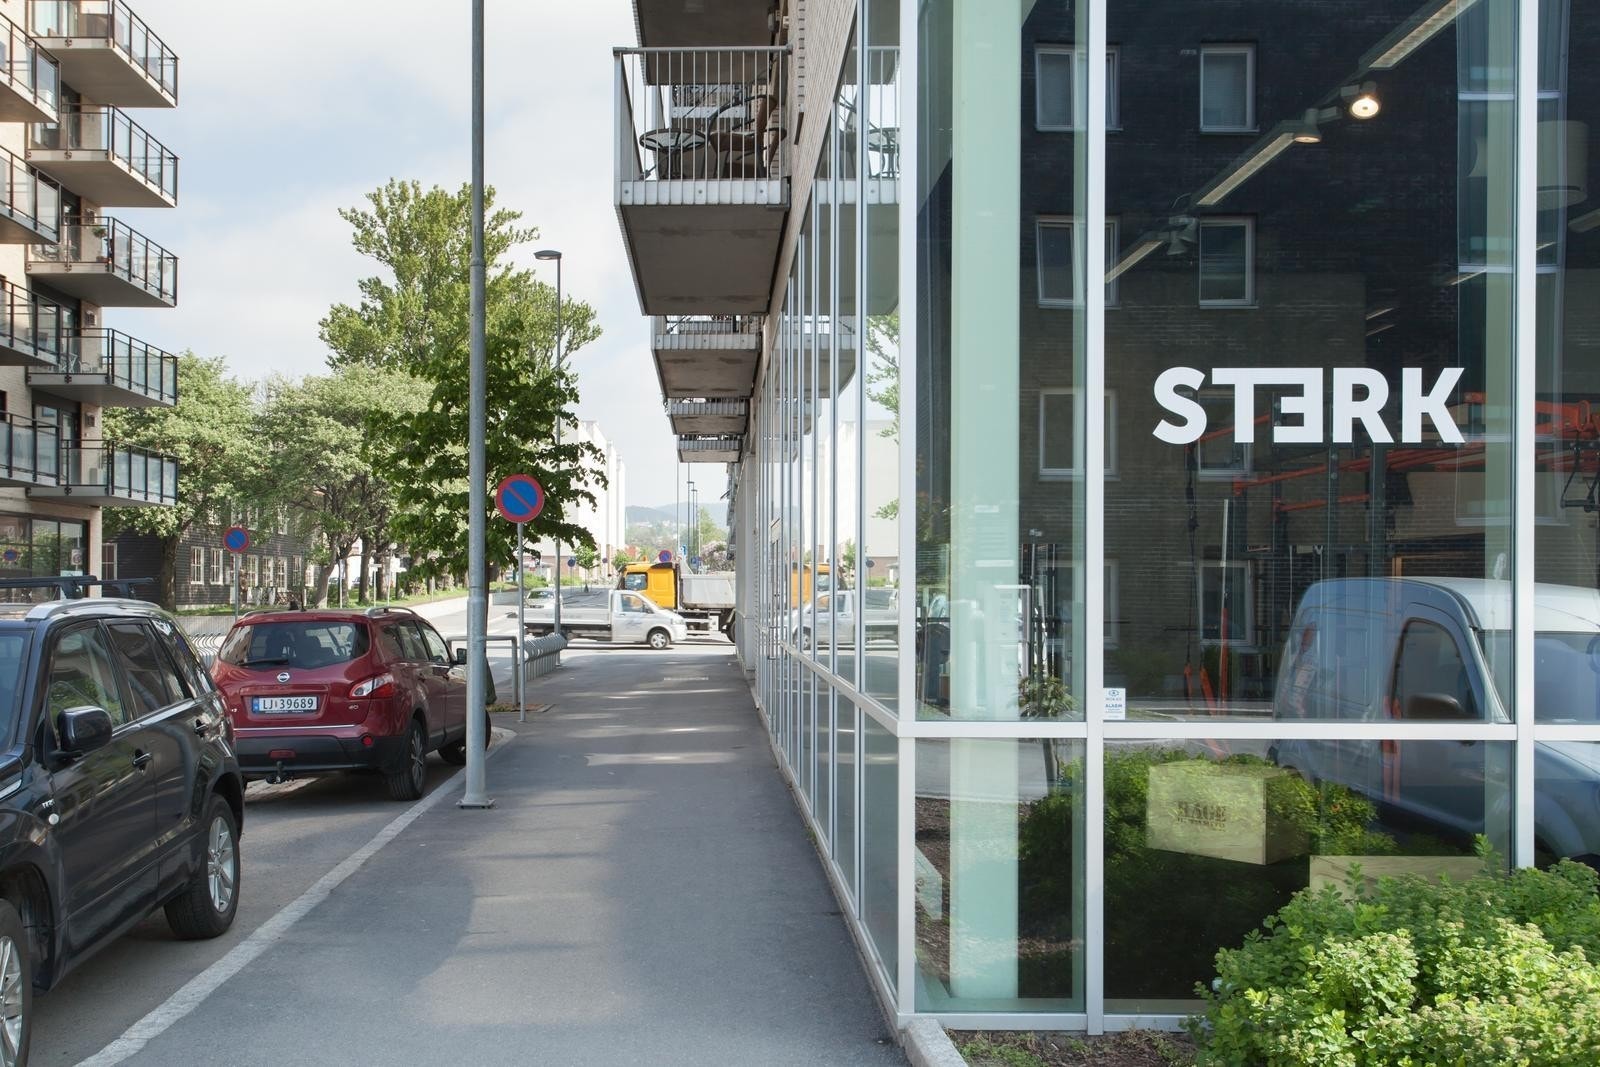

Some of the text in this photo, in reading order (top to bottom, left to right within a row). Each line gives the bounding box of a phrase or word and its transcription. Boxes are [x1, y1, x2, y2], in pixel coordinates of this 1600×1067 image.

[1152, 366, 1466, 444] STERK
[263, 698, 314, 710] LJ 39689
